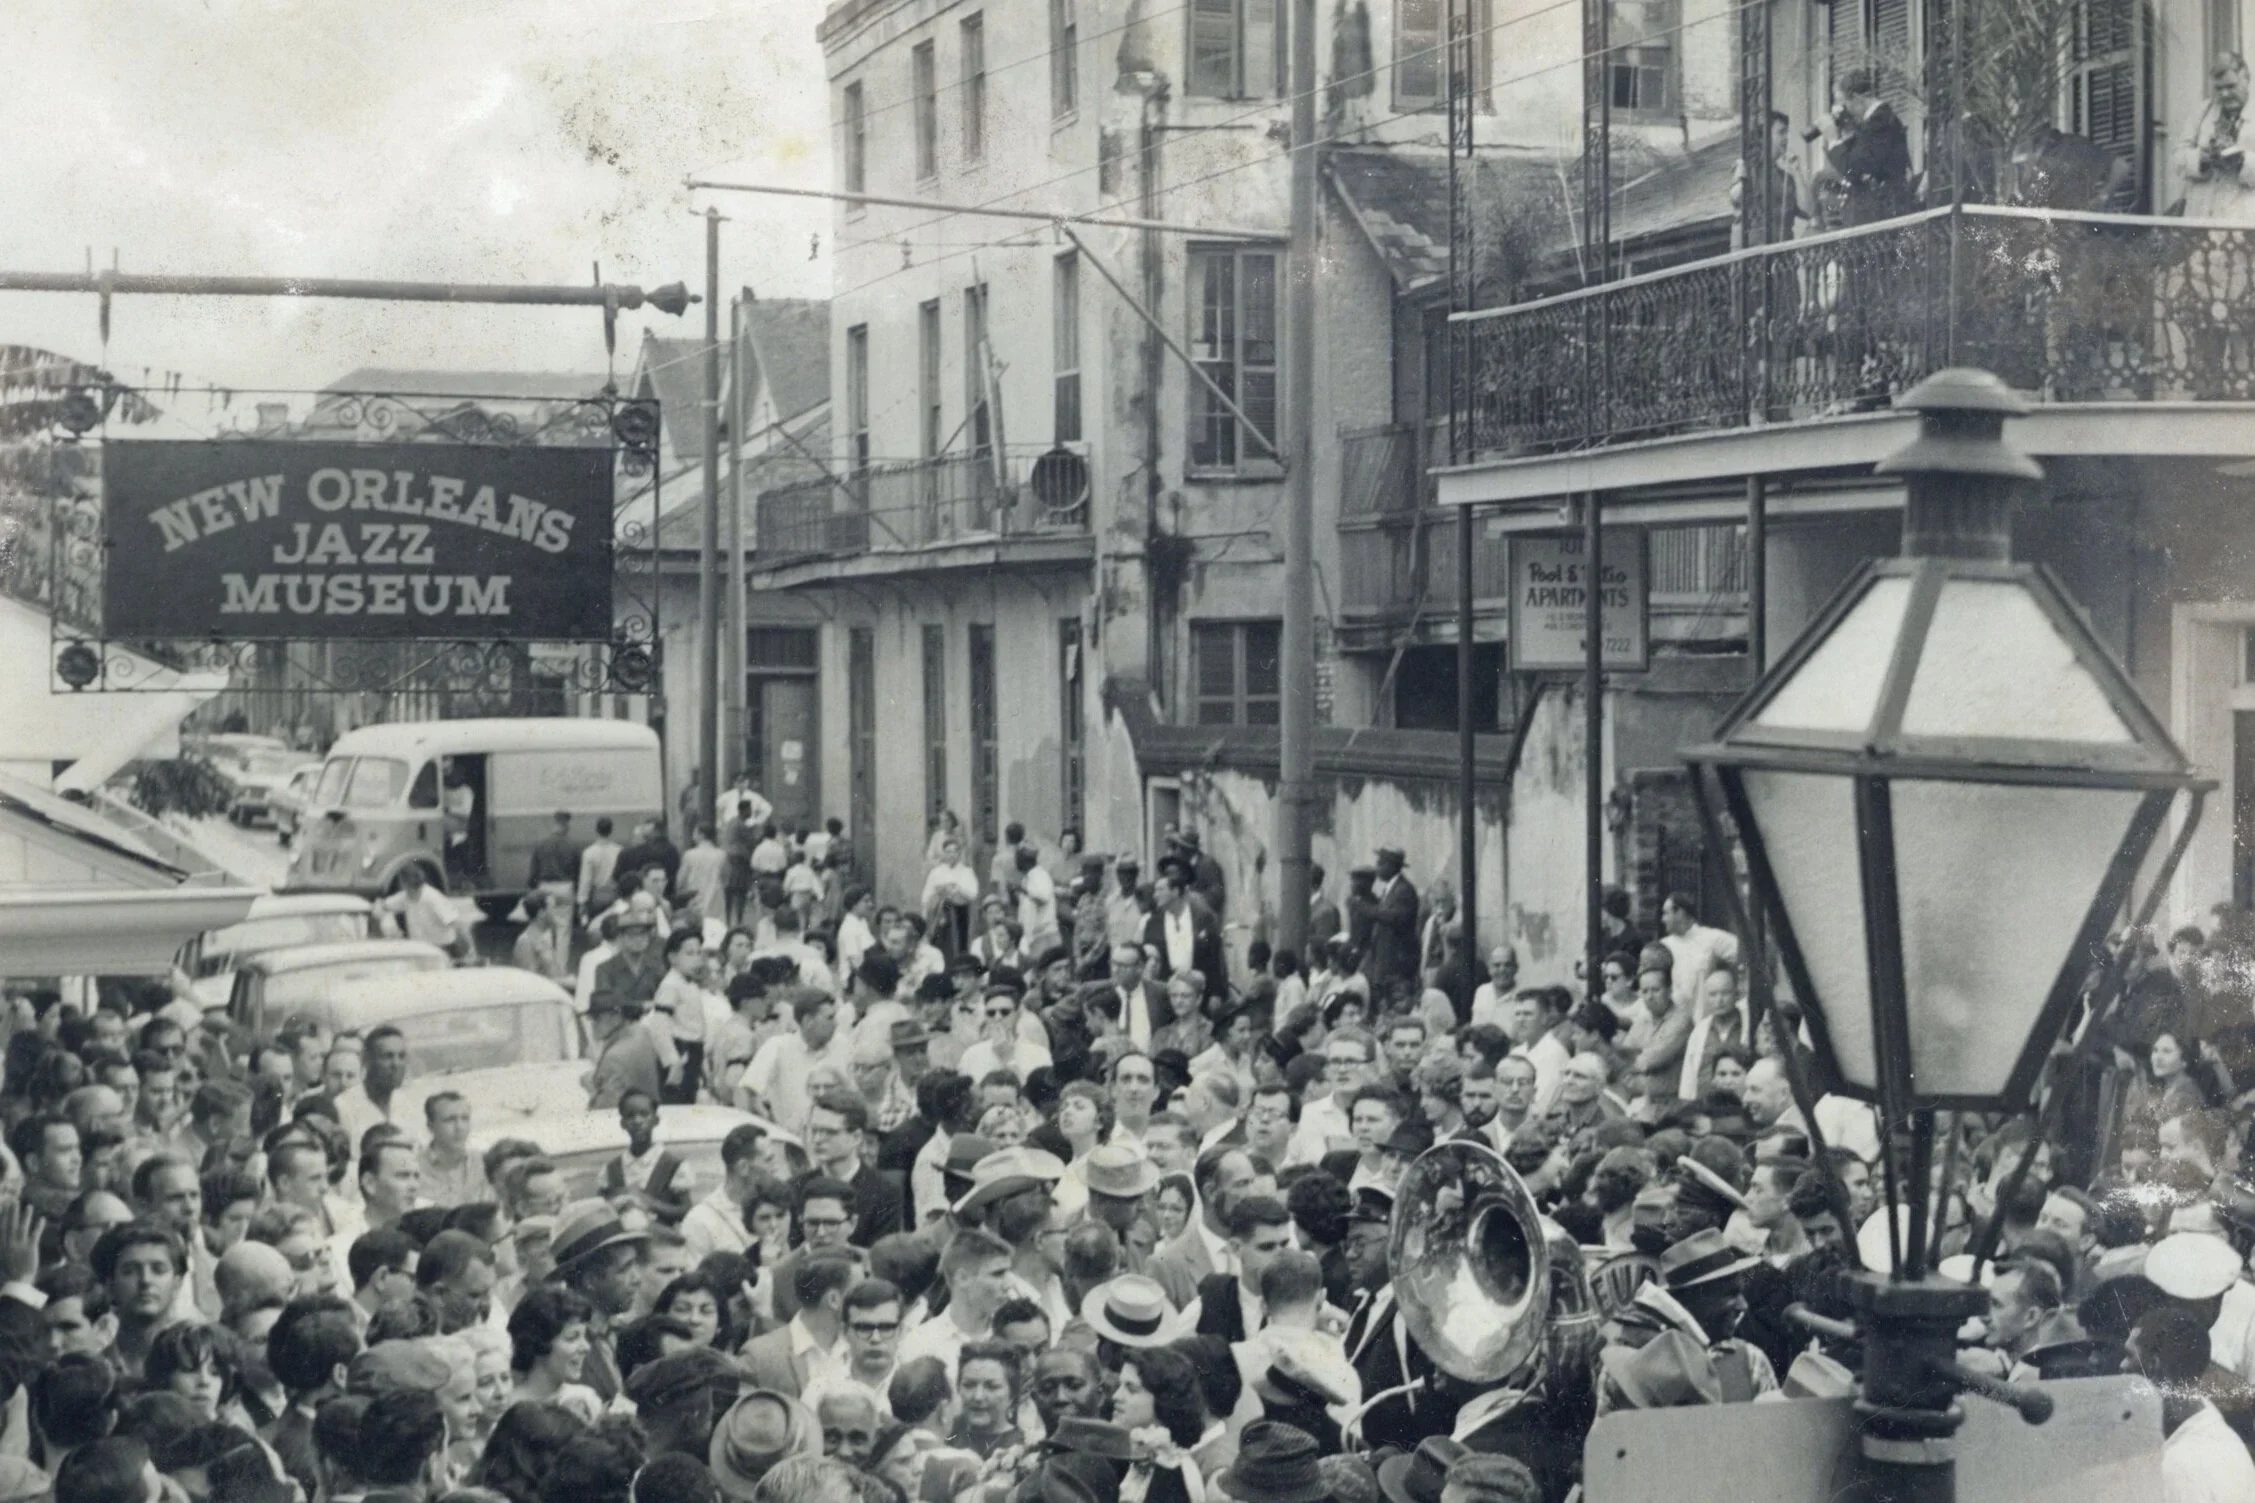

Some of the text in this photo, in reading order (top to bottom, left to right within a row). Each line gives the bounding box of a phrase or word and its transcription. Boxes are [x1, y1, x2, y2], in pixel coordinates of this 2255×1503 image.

[148, 467, 577, 555] NEW ORLEANS
[272, 521, 435, 565] JAZZ
[219, 573, 513, 615] MUSEUM
[1528, 562, 1562, 583] Pool
